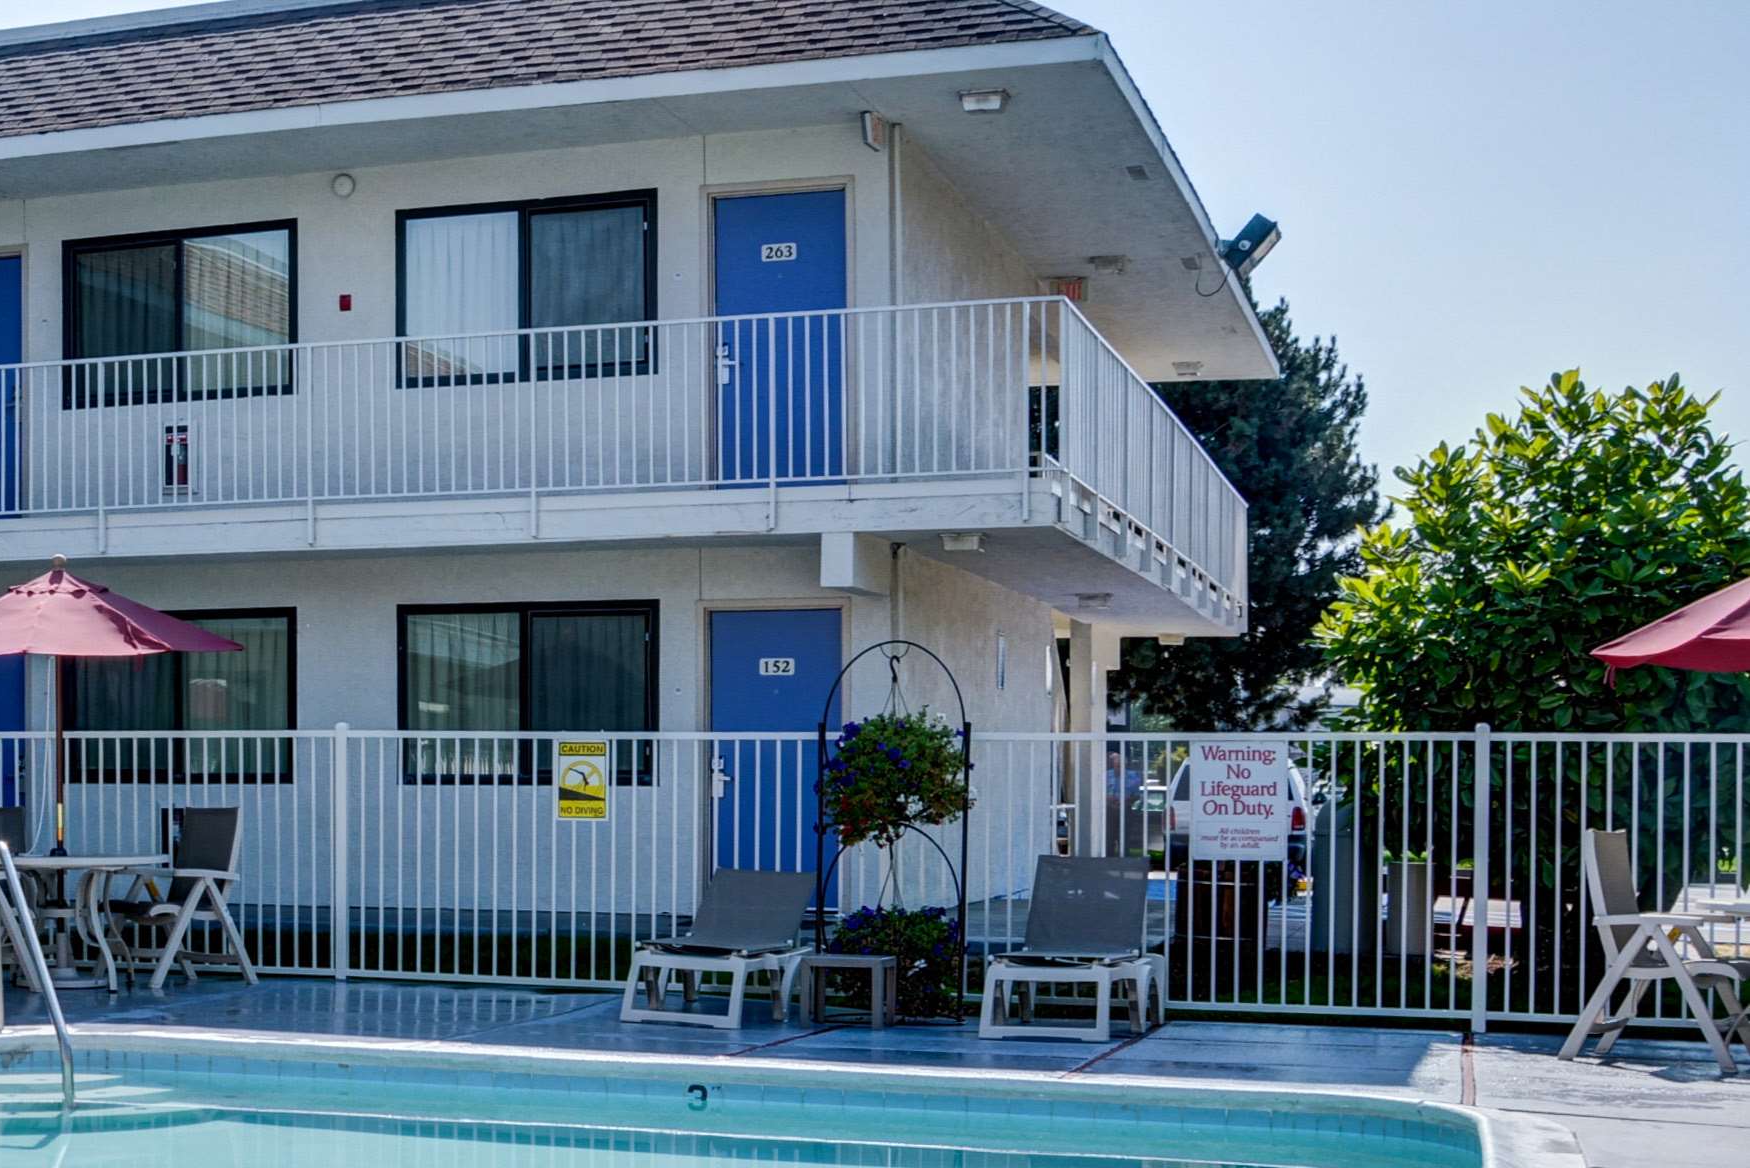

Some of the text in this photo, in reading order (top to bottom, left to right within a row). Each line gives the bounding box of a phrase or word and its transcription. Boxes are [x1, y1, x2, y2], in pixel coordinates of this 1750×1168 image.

[765, 244, 793, 259] 263
[764, 660, 791, 673] 152
[561, 744, 603, 753] CAUTION
[1200, 745, 1277, 766] Warning:
[1226, 764, 1251, 779] No
[1200, 781, 1278, 800] Lifeguard
[560, 806, 604, 815] NO DIVING
[1203, 799, 1275, 820] On Duty.
[687, 1084, 708, 1111] 3
